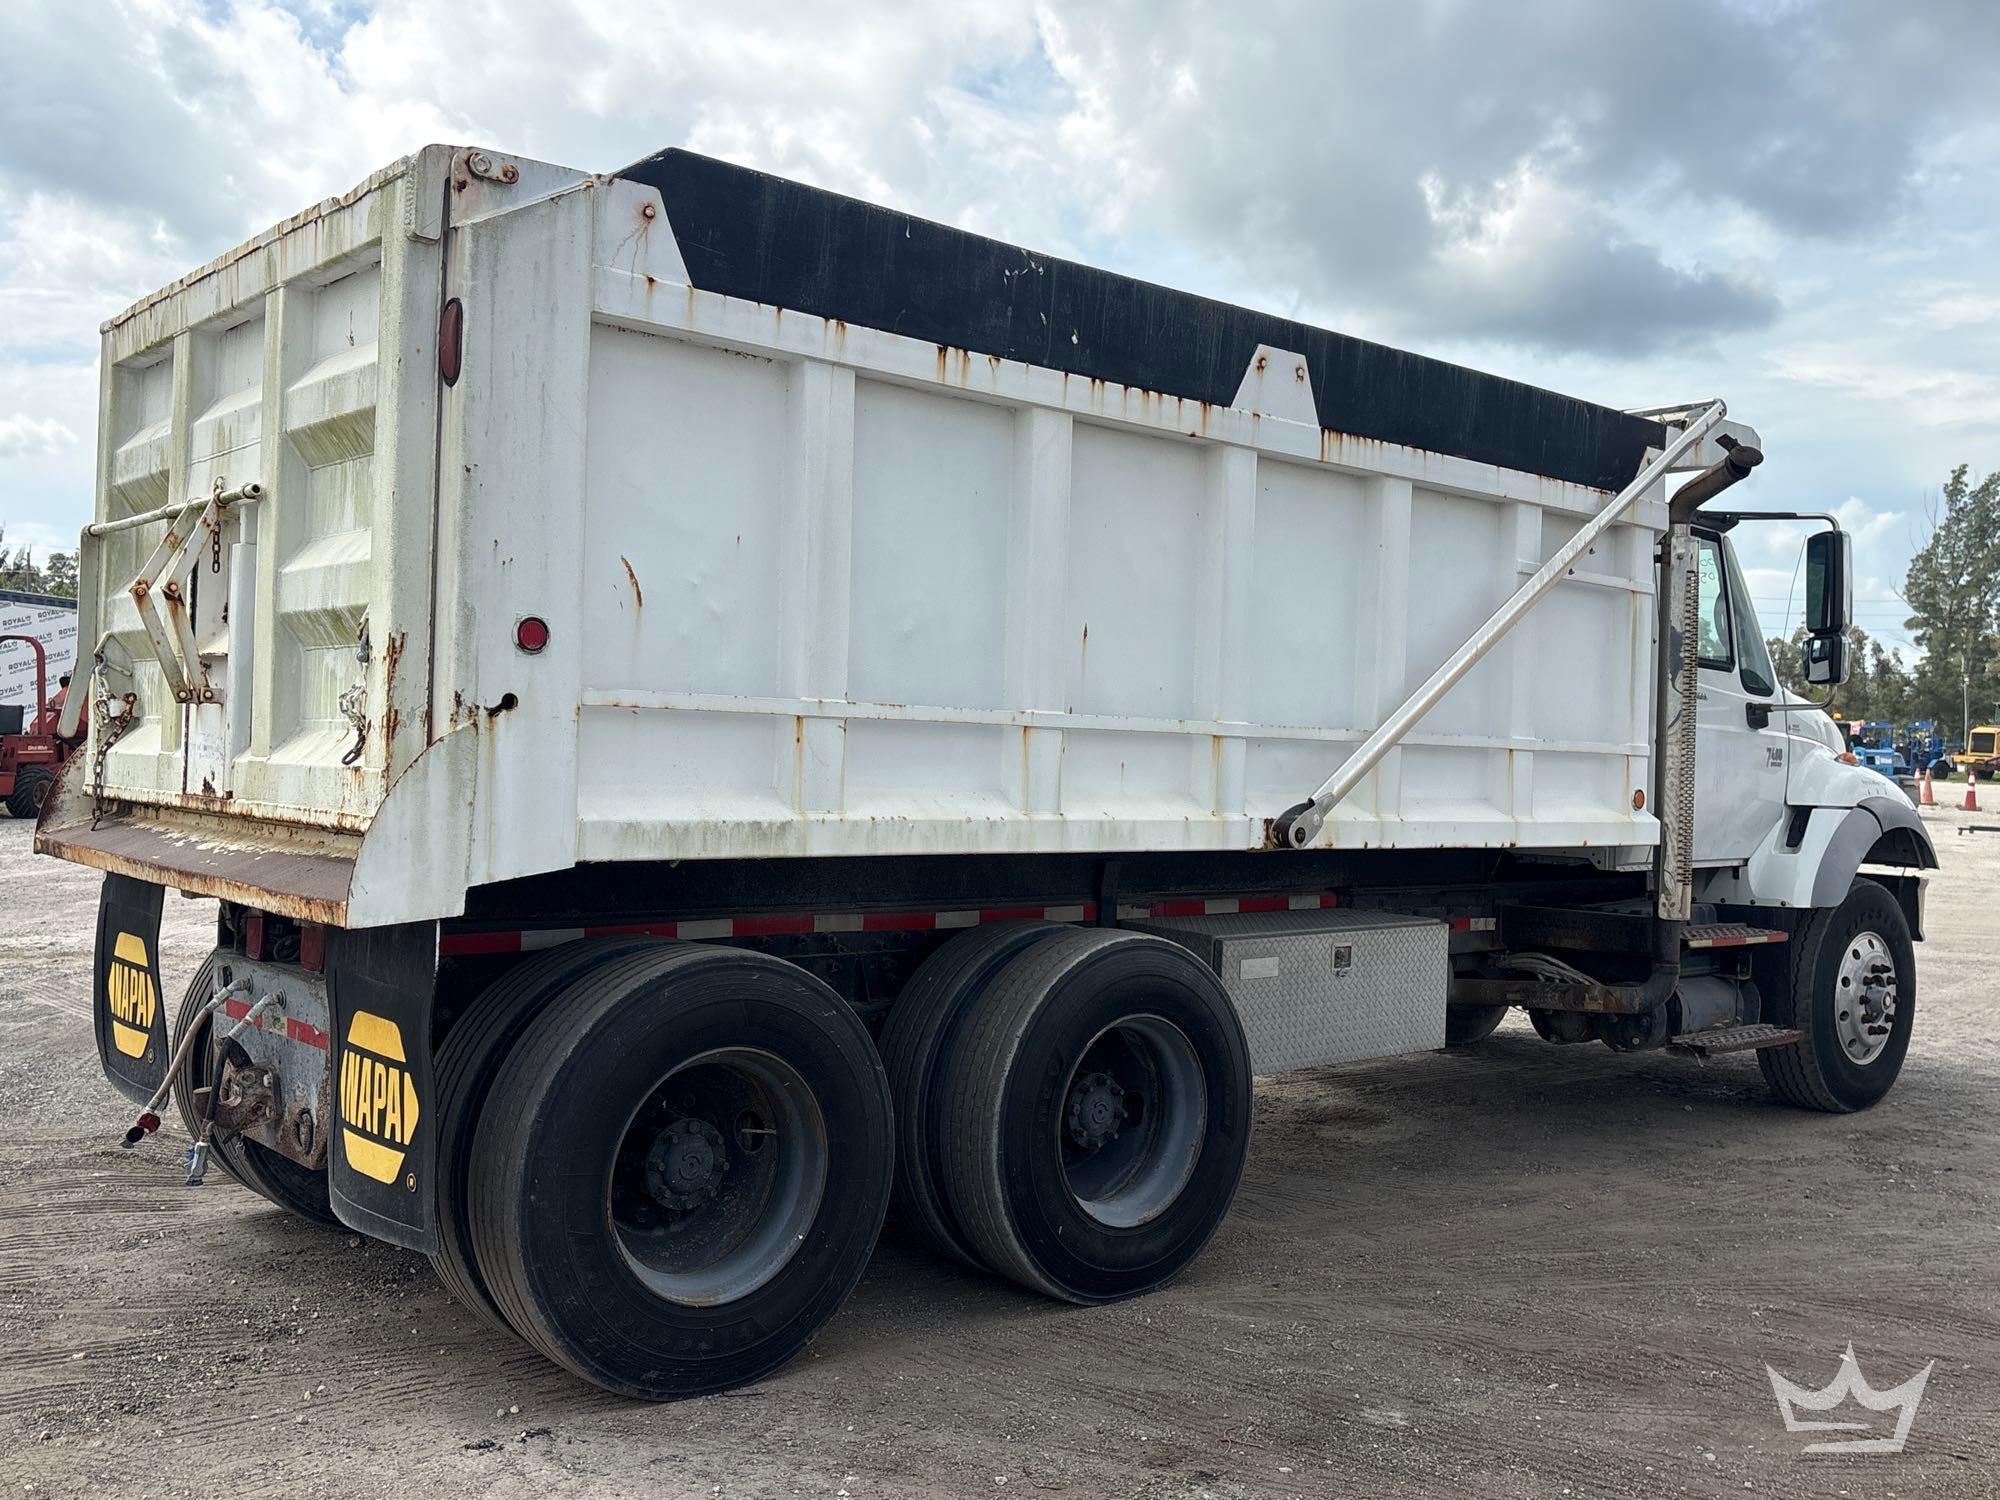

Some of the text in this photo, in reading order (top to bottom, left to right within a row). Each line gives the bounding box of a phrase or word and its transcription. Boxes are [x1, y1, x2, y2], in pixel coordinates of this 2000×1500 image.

[37, 609, 60, 618] ROYAL
[2, 616, 26, 626] ROYAL
[8, 660, 31, 670] ROYAL
[0, 686, 17, 695] OYAL
[114, 962, 148, 1028] NAPA
[345, 1051, 402, 1144] NAPA
